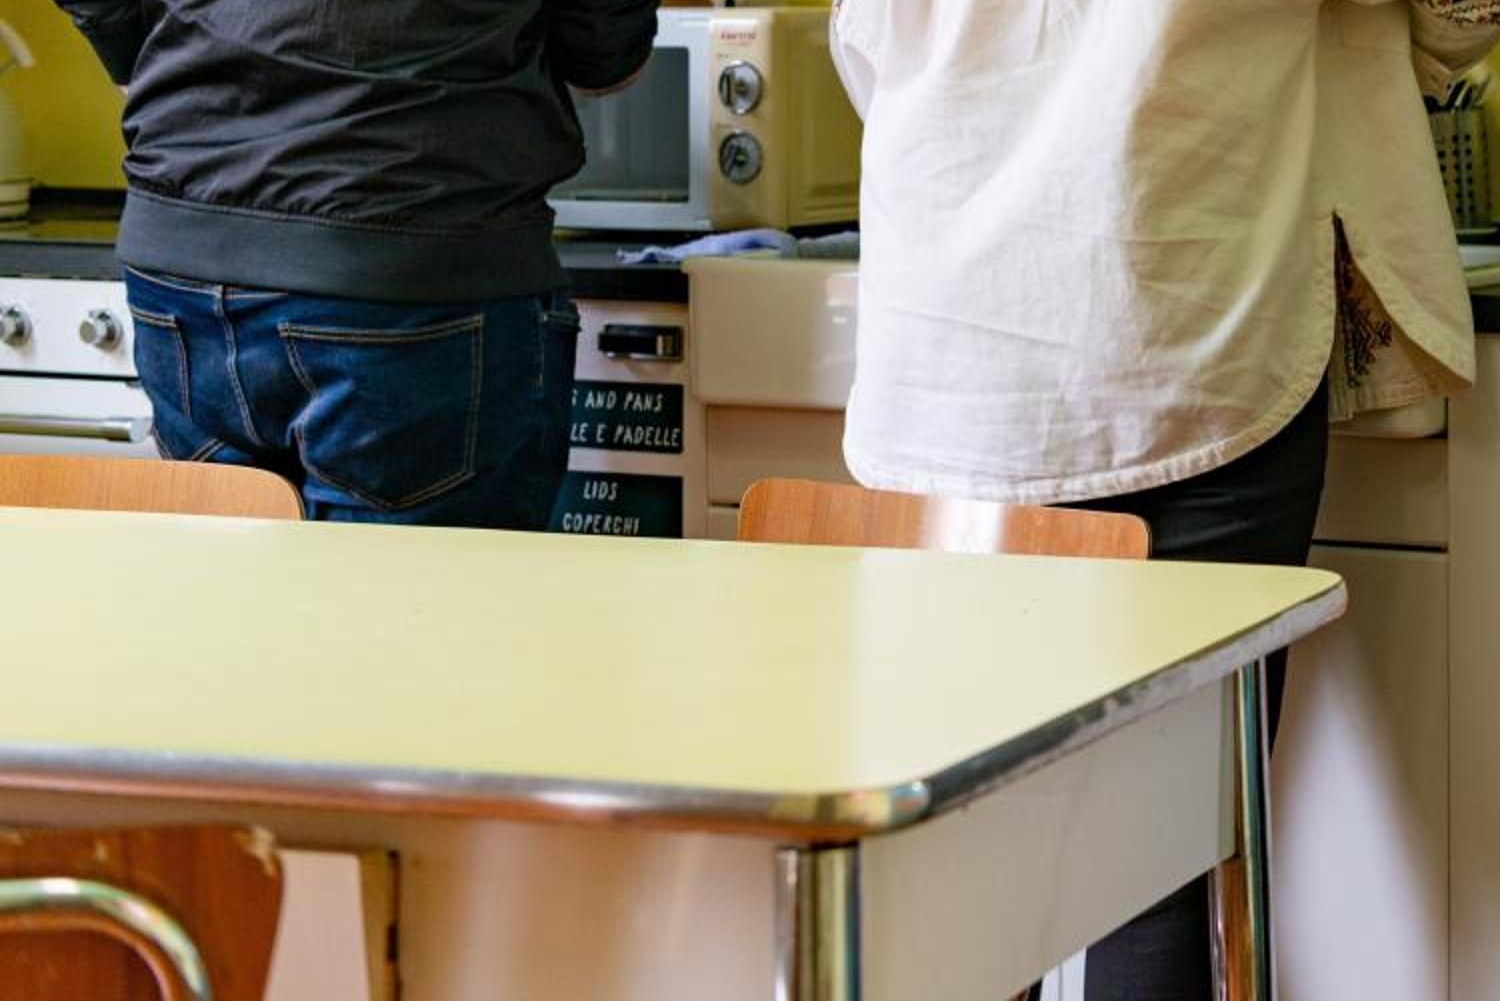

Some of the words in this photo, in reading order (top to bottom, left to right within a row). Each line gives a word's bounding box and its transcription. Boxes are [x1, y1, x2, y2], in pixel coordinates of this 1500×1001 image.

[585, 390, 617, 410] AND
[623, 391, 664, 412] PANS
[569, 421, 589, 443] LE
[596, 423, 607, 443] E
[613, 424, 681, 448] PADELLE
[583, 480, 618, 501] LIDS
[562, 512, 641, 536] COPERCHI
